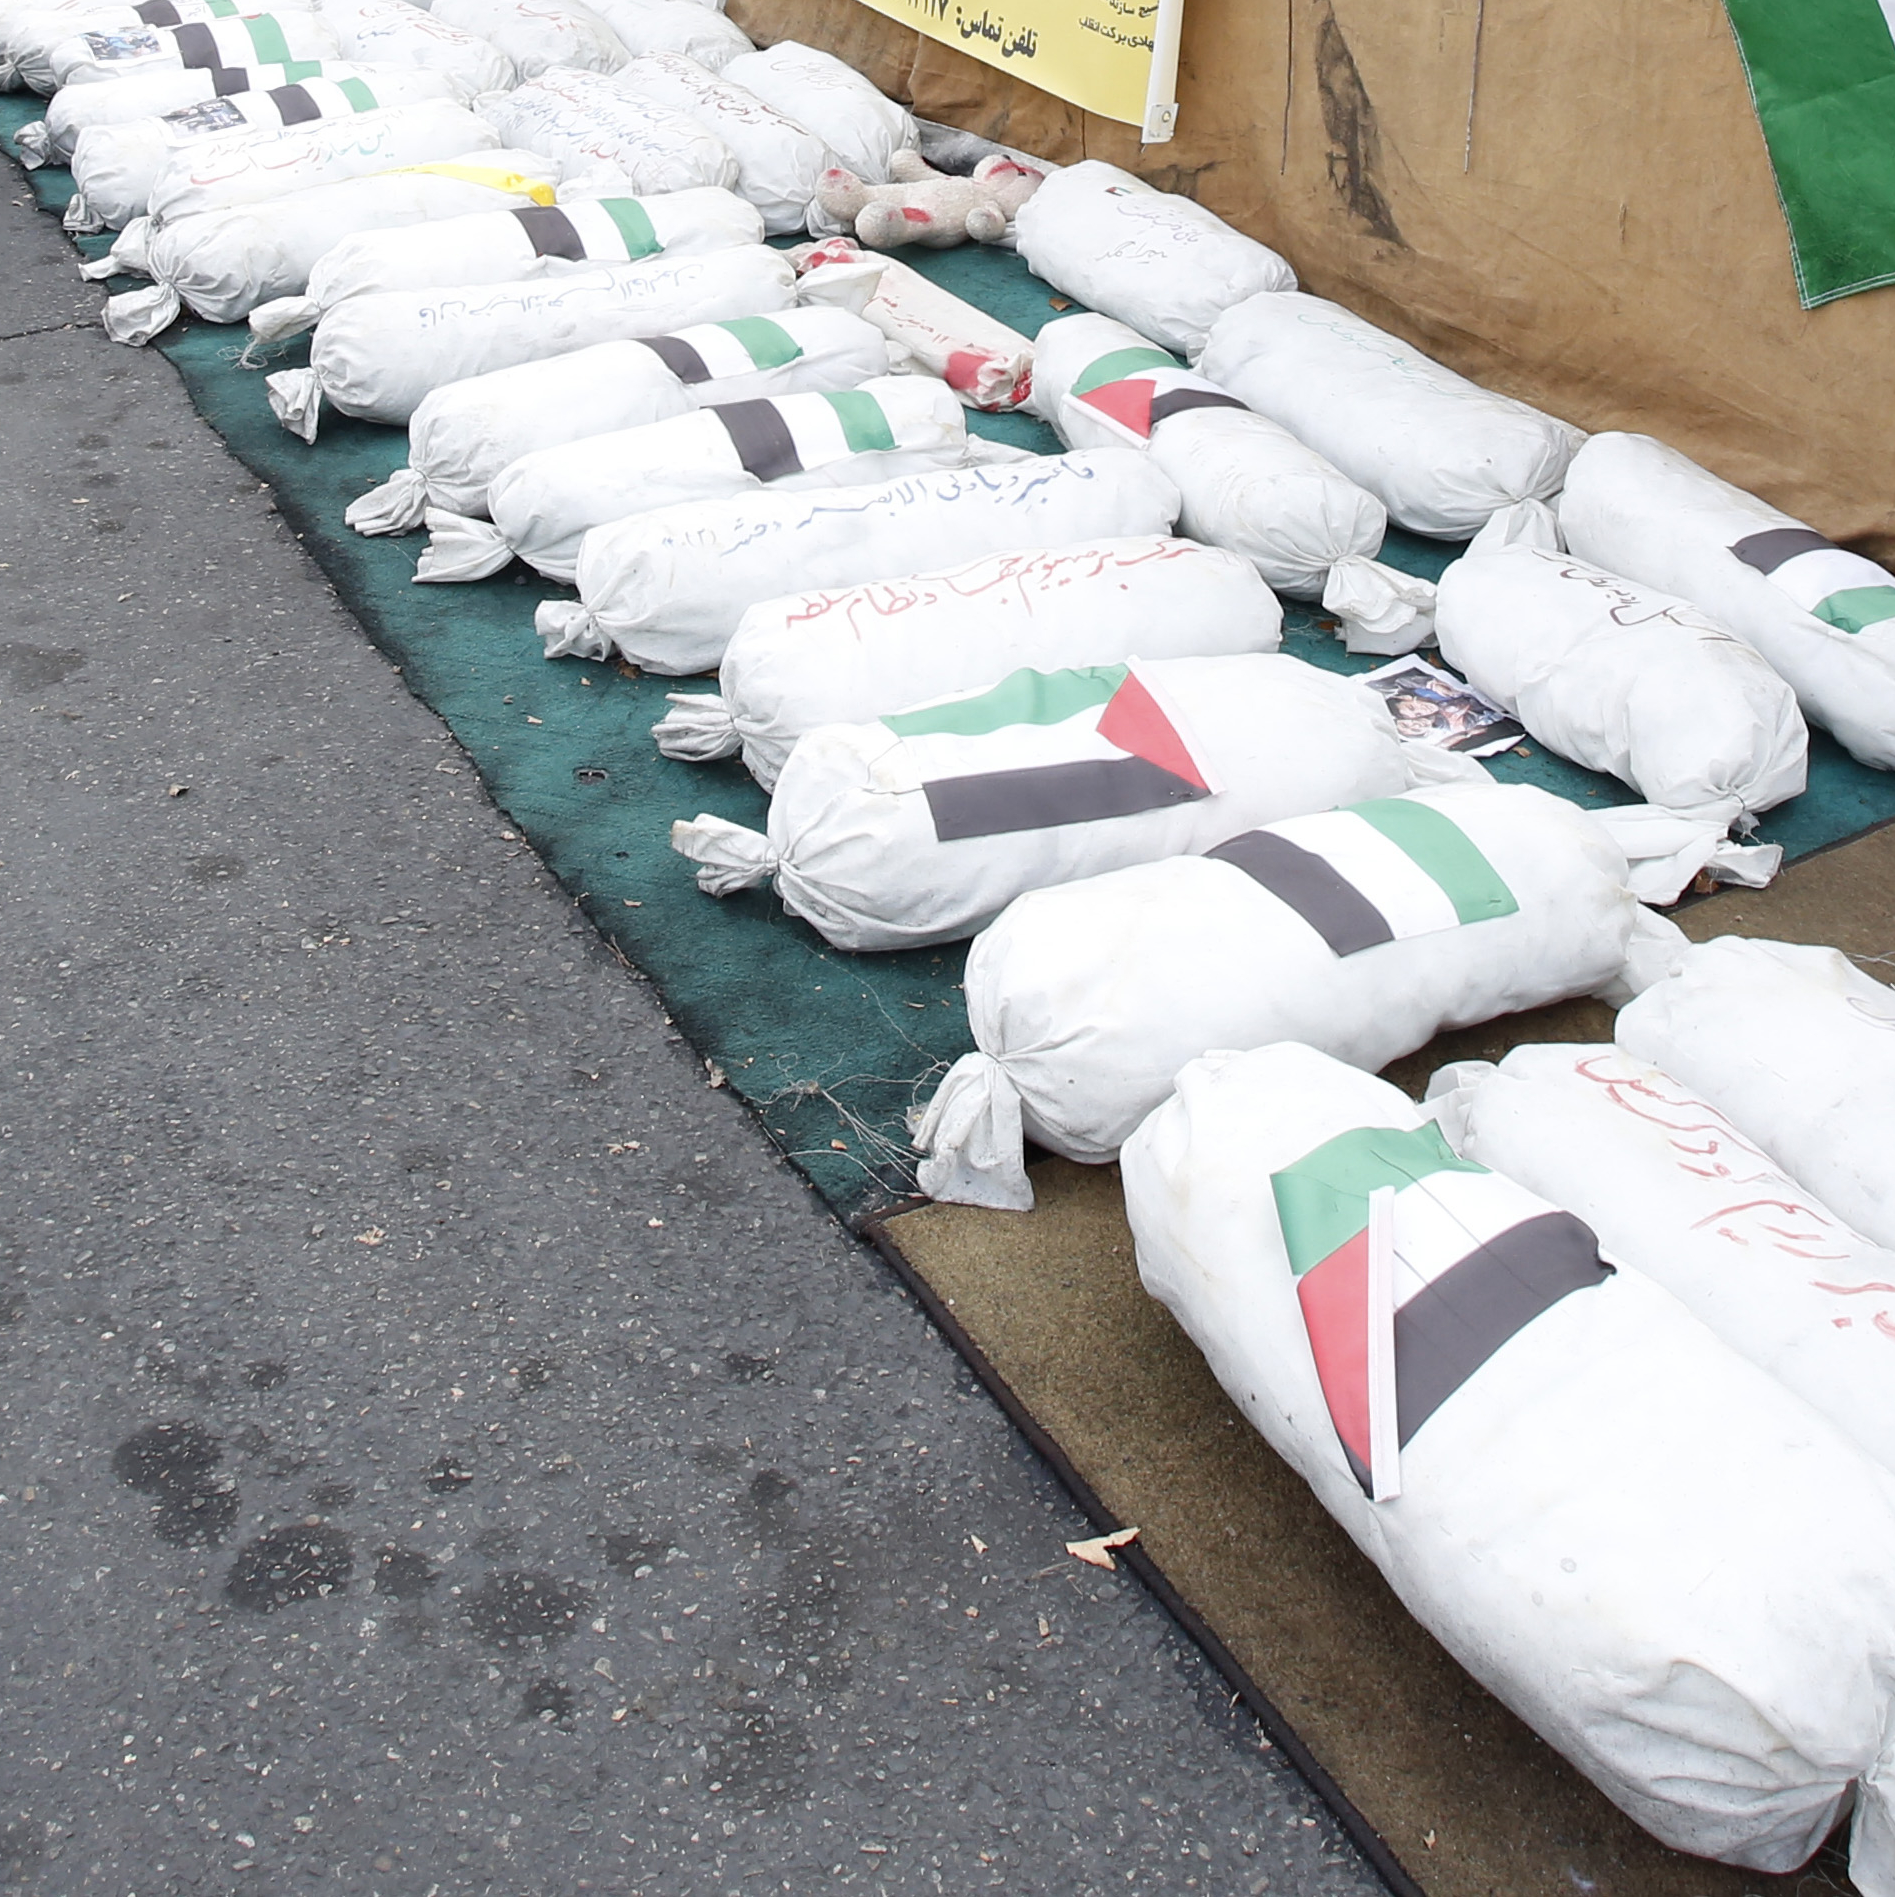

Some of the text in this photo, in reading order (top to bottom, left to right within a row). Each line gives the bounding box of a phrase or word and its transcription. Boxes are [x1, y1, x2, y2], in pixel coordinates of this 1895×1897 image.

[955, 6, 1002, 41] تماس:
[1100, 25, 1127, 46] برکت
[1003, 27, 1037, 59] تلفن
